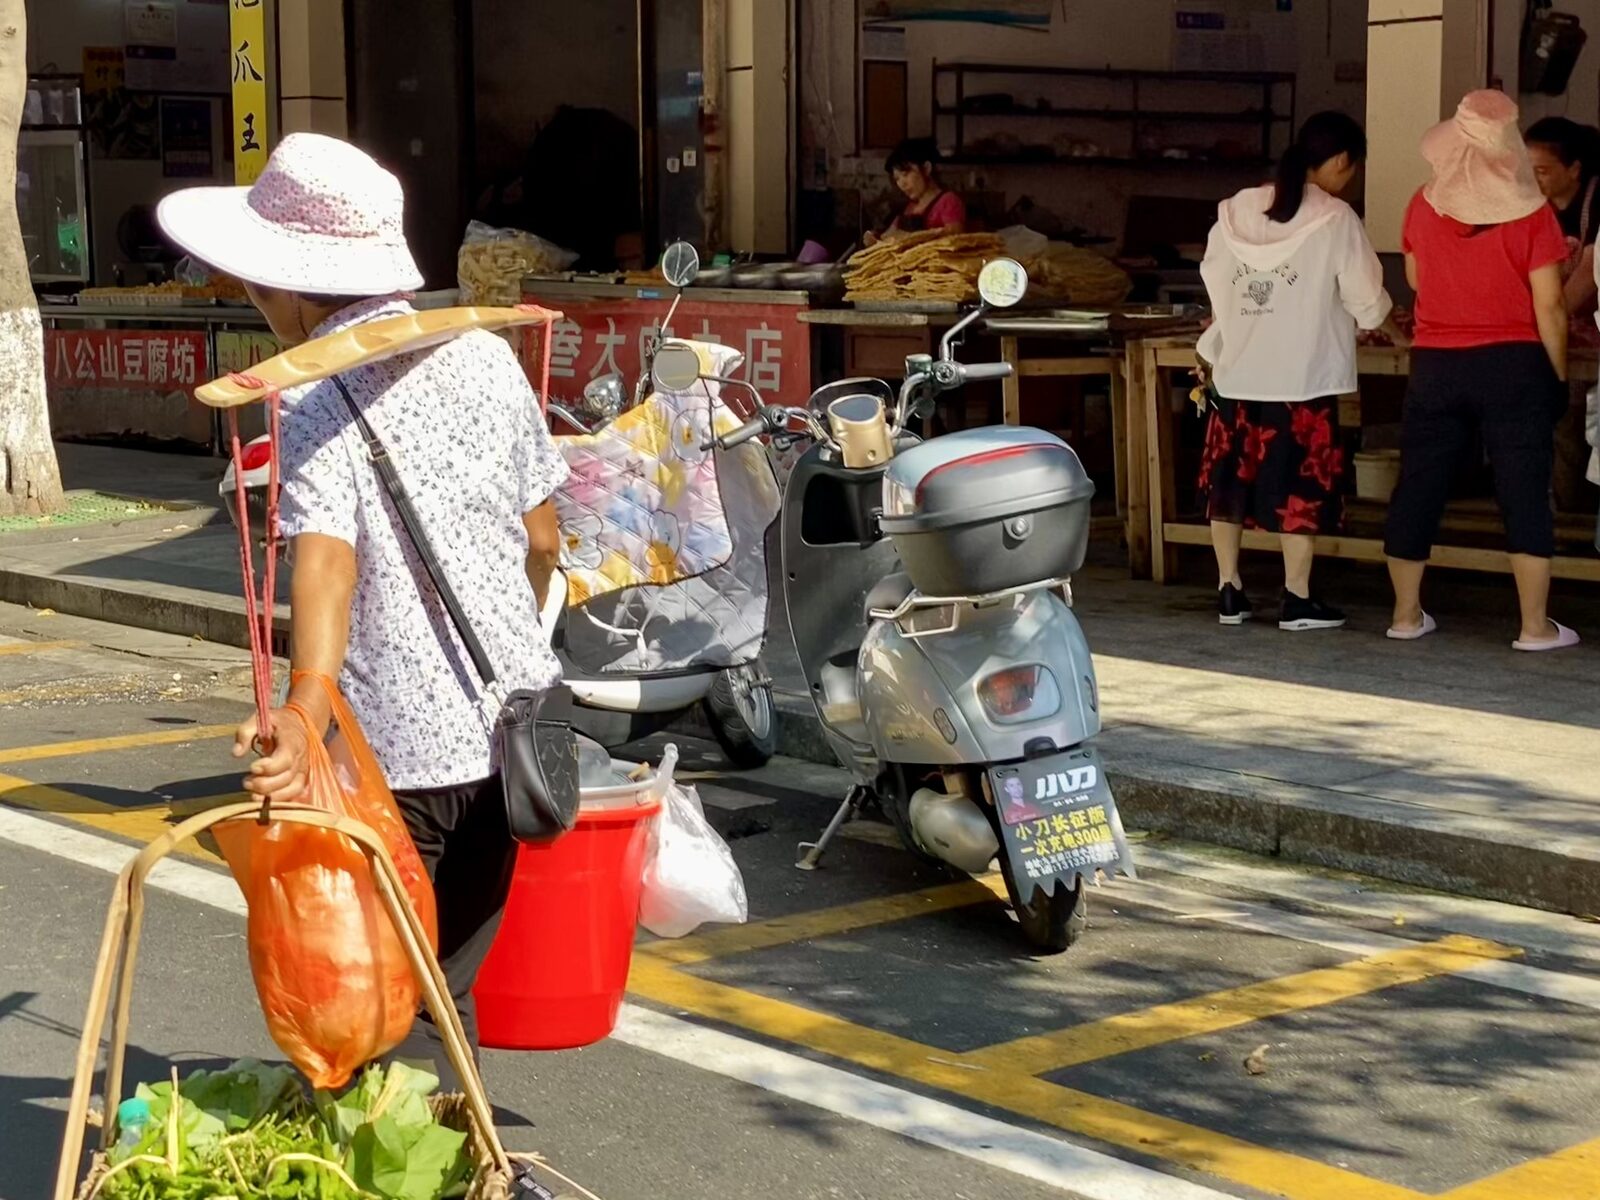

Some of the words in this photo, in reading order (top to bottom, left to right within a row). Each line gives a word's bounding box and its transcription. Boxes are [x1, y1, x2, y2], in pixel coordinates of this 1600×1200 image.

[53, 337, 195, 384] 八公山豆腐坊
[1015, 804, 1107, 840] 小刀长征版
